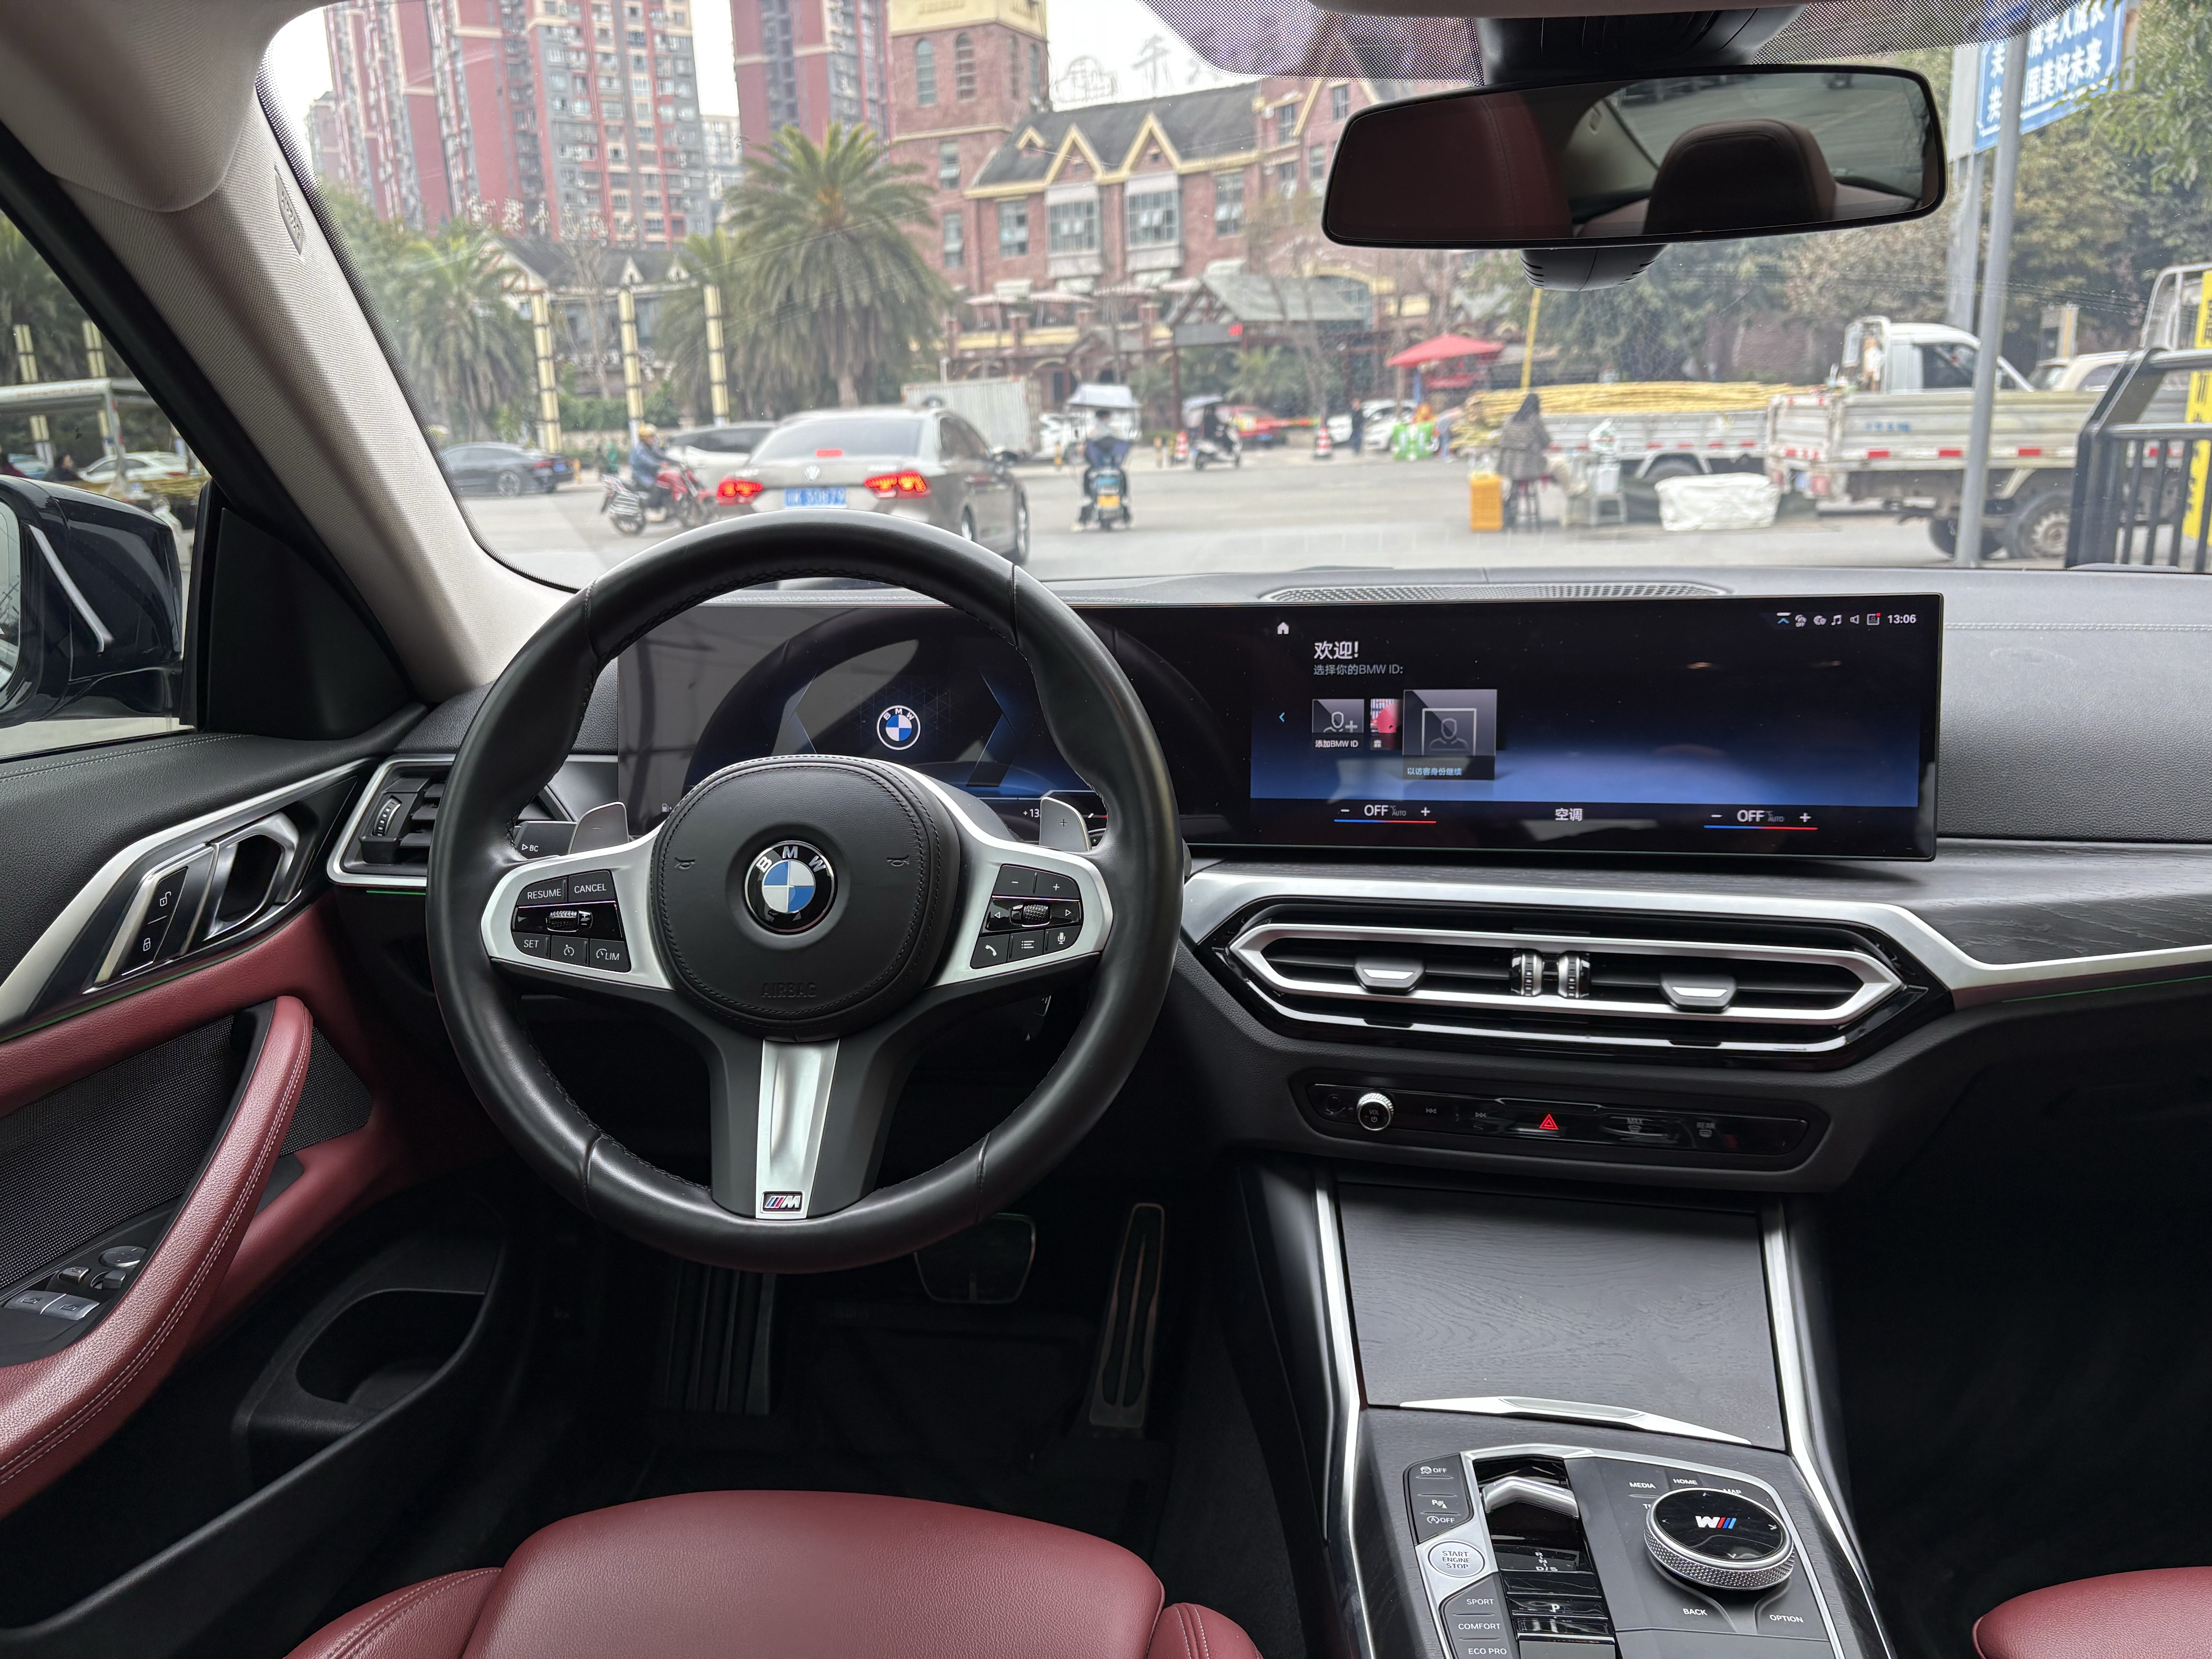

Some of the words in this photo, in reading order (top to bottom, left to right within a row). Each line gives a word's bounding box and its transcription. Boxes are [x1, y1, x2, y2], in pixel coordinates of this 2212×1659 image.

[1887, 614, 1917, 624] 13:06
[1314, 641, 1358, 659] 欢迎!
[1314, 664, 1386, 675] 选择你的BMW
[1389, 664, 1403, 675] ID:
[883, 708, 915, 721] BMW
[1315, 740, 1349, 748] 添加BMW
[1407, 768, 1462, 776] 以访客身份继续
[1364, 805, 1389, 816] OFF
[1555, 808, 1583, 821] 空调
[1737, 810, 1765, 822] OFF
[756, 846, 826, 873] BMW
[527, 889, 562, 900] RESUME
[574, 883, 607, 893] CANCEL
[524, 940, 539, 948] SET
[605, 953, 620, 961] LIM
[1550, 1603, 1560, 1613] P
[1769, 1614, 1804, 1623] OPTION
